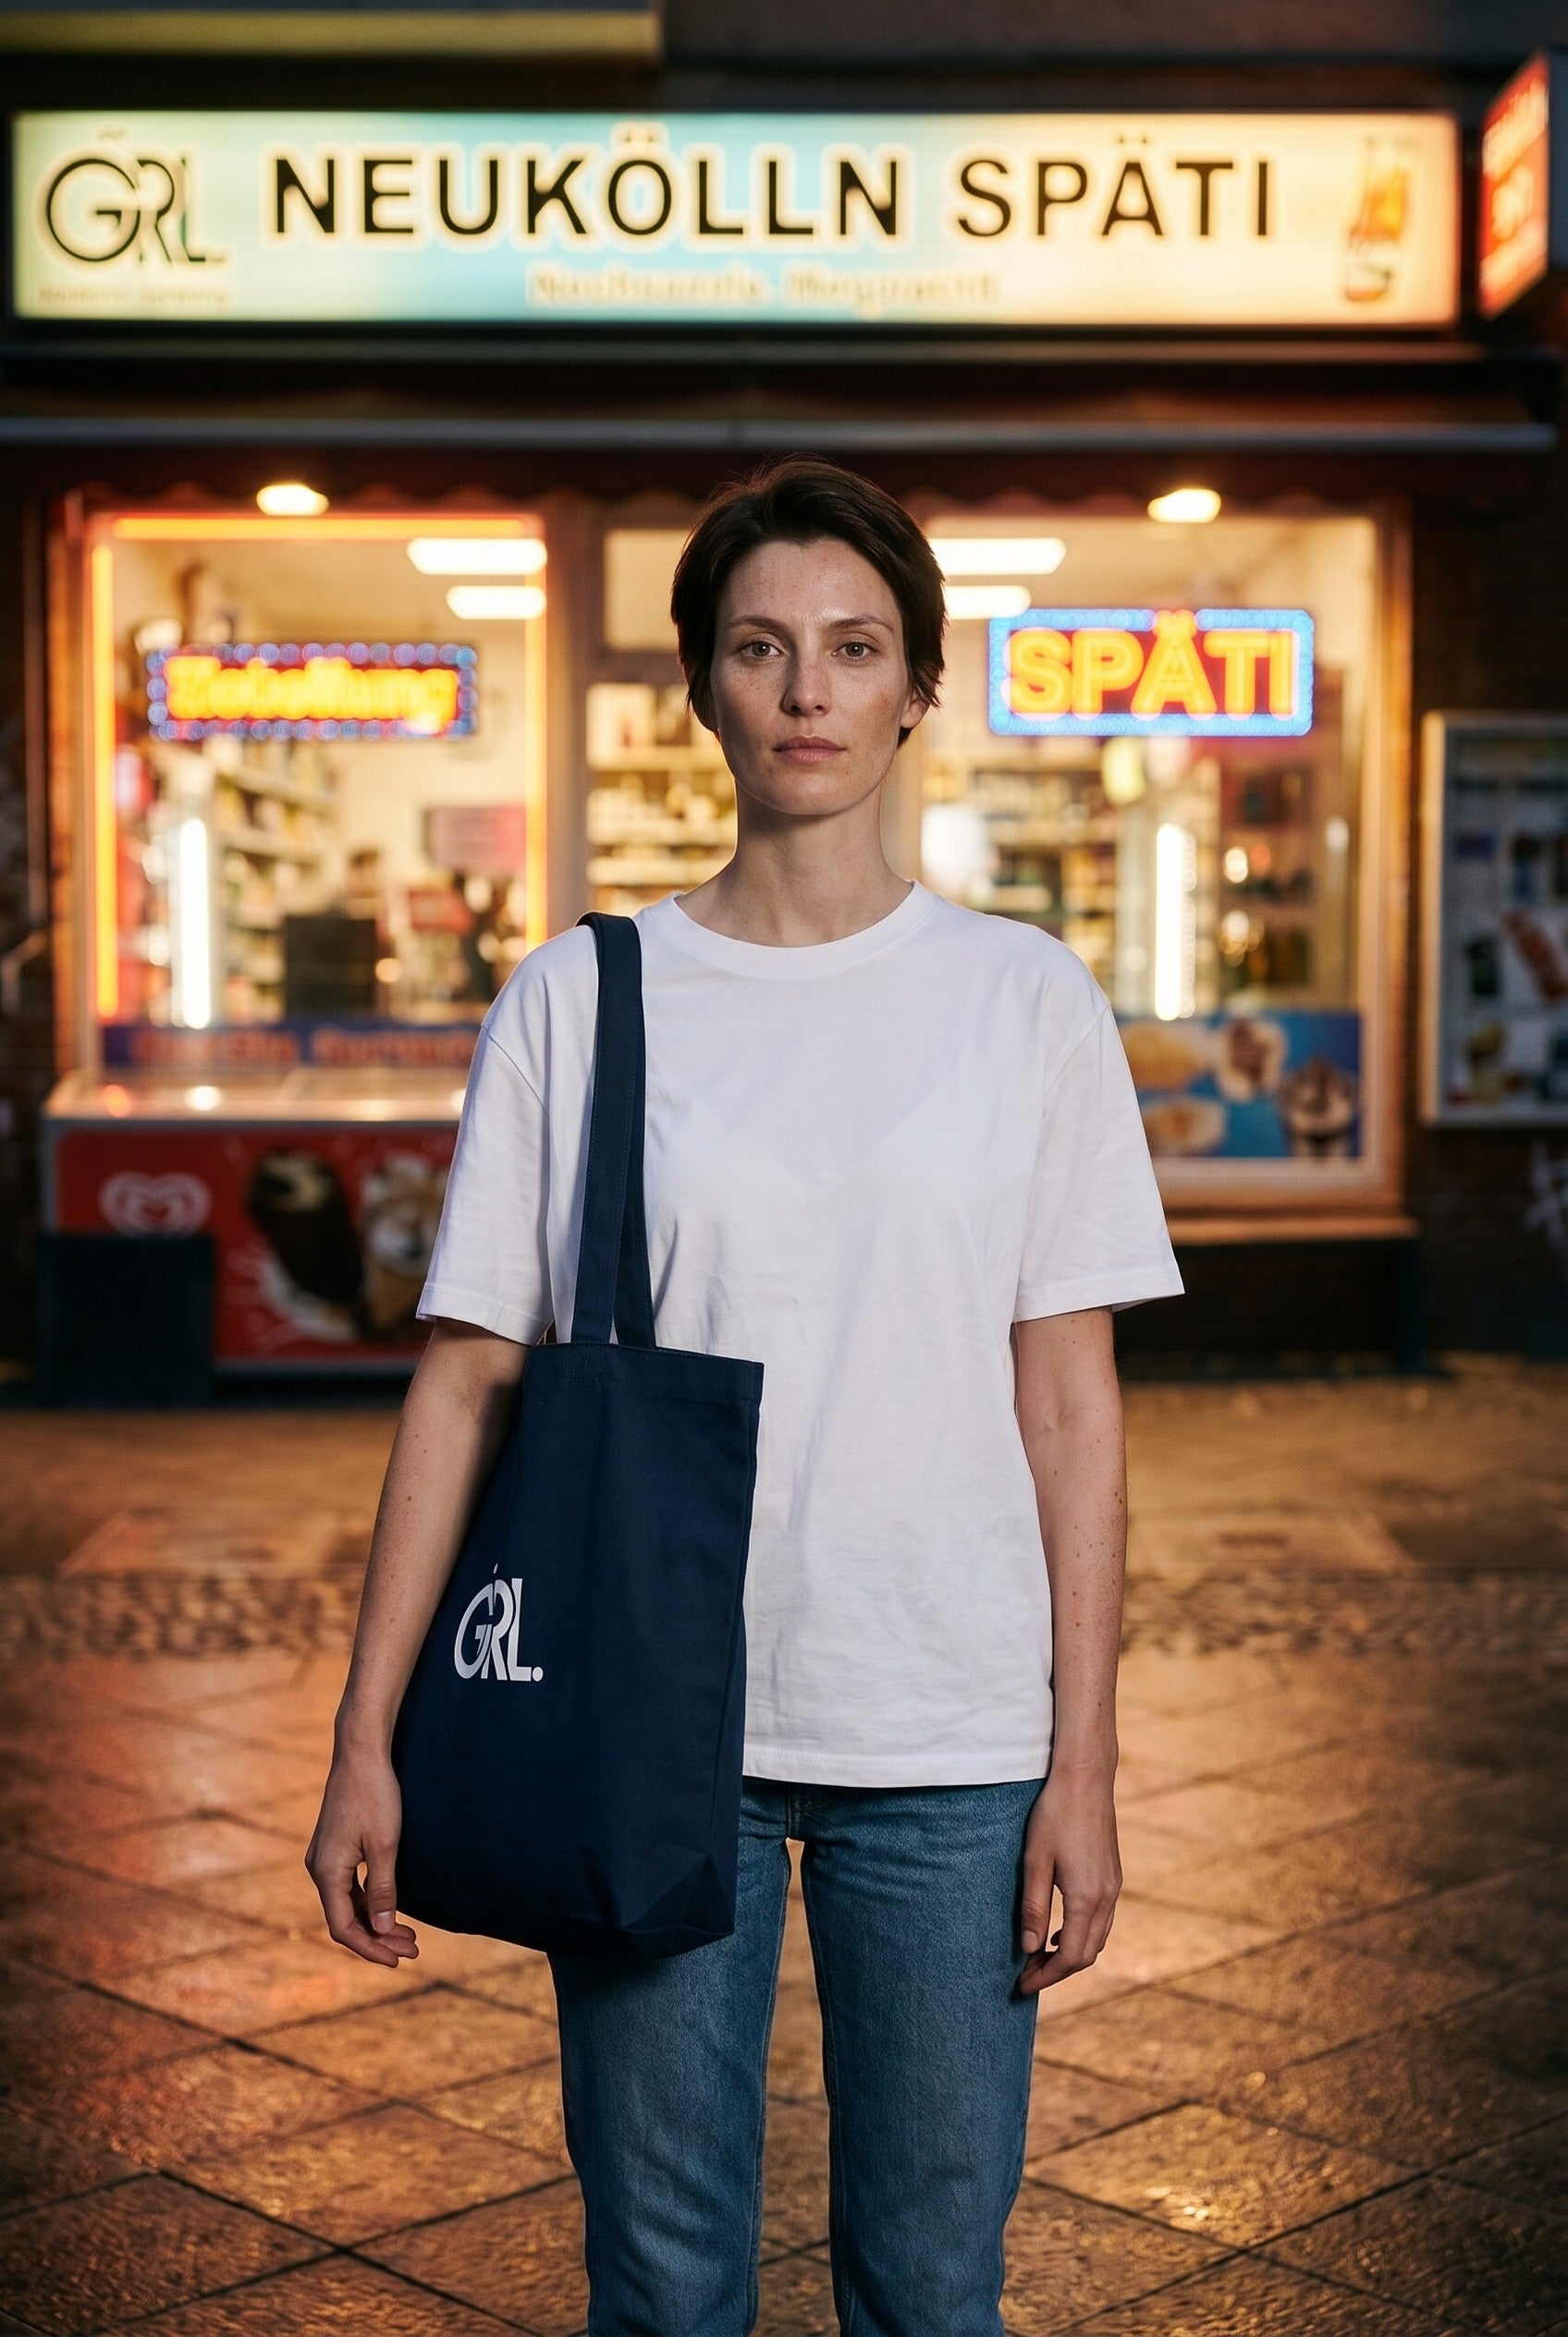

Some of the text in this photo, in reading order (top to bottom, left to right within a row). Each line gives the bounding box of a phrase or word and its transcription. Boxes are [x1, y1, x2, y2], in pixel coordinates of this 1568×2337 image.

[276, 134, 1268, 239] NEUKÖLLN SPÄTI
[1008, 610, 1298, 717] SPÄTI
